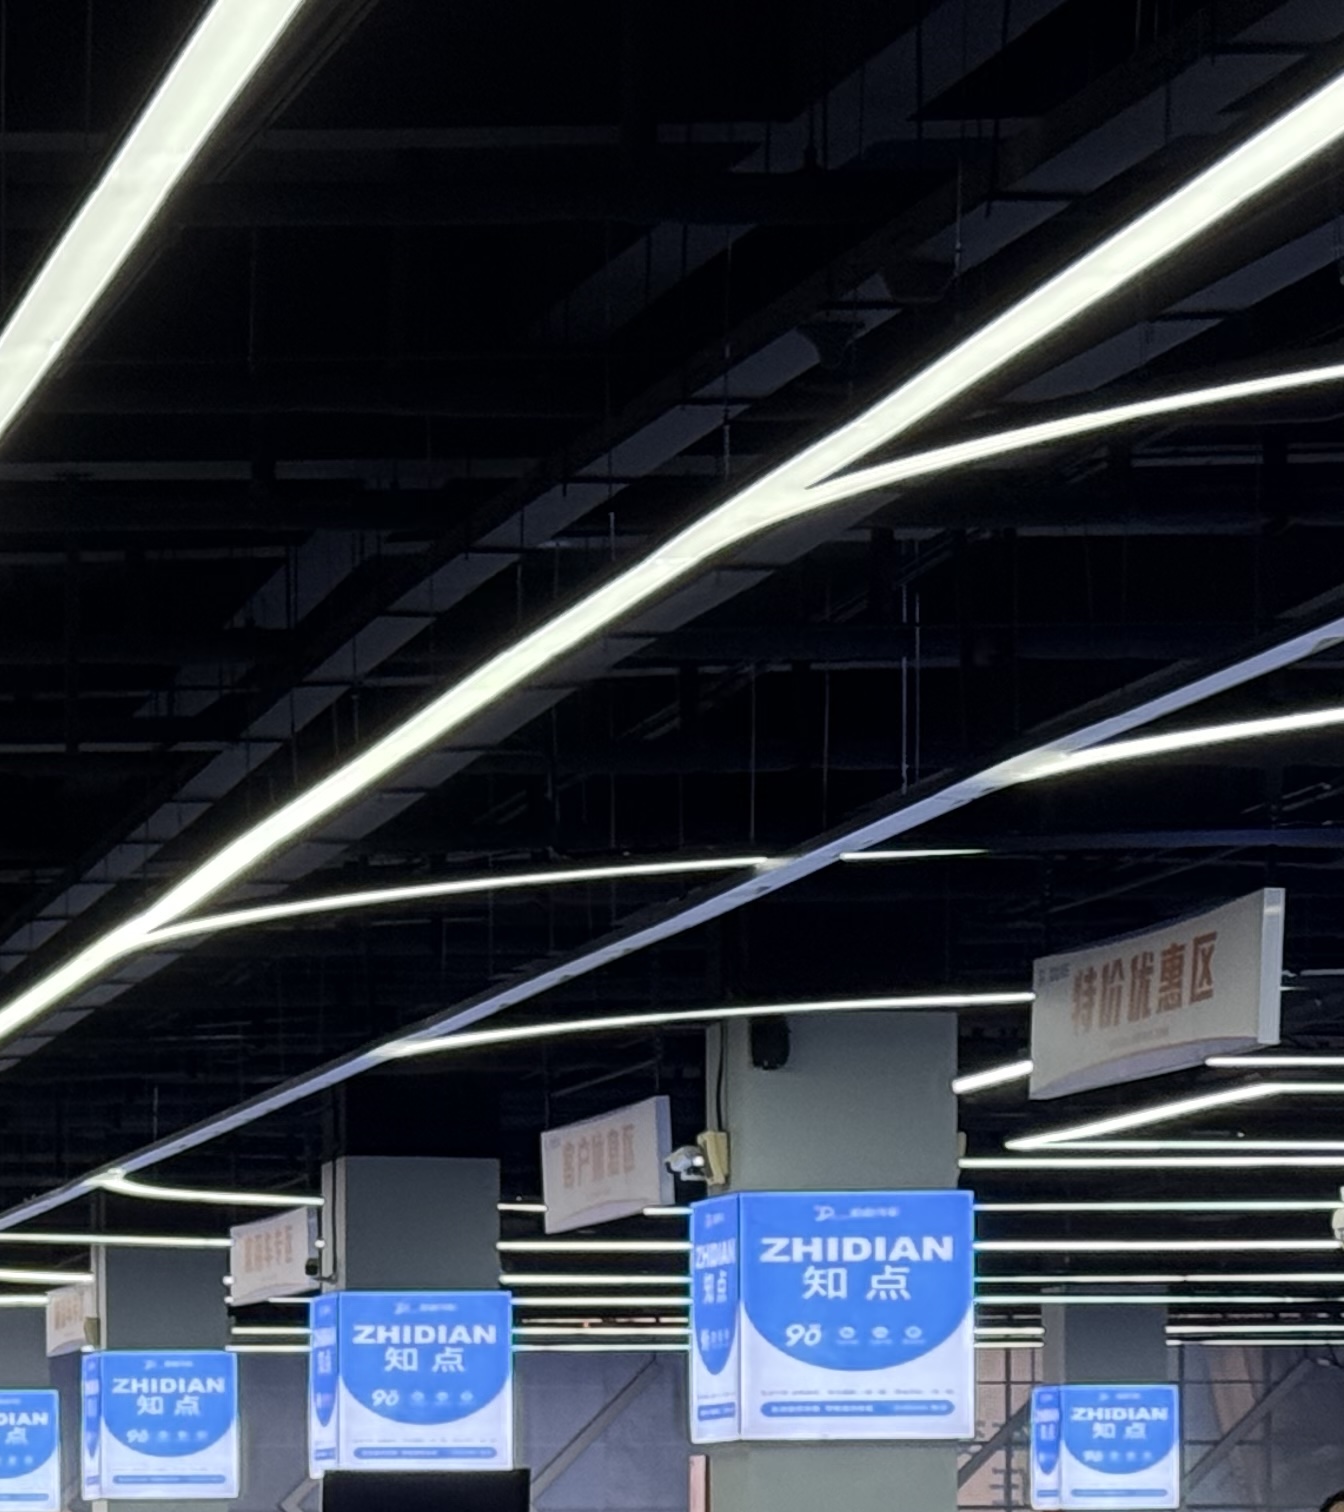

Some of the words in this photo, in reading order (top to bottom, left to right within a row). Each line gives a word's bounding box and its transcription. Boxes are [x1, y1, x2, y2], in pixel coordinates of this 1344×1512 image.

[1071, 930, 1218, 1036] 特价优惠区
[759, 1235, 954, 1263] ZHIDIAN
[802, 1265, 912, 1300] 知点
[352, 1324, 498, 1345] ZHIDIAN
[384, 1346, 466, 1373] 知点
[112, 1377, 226, 1394] ZHIDIAN
[136, 1394, 201, 1417] 知点
[1070, 1406, 1169, 1422] ZHIDIAN
